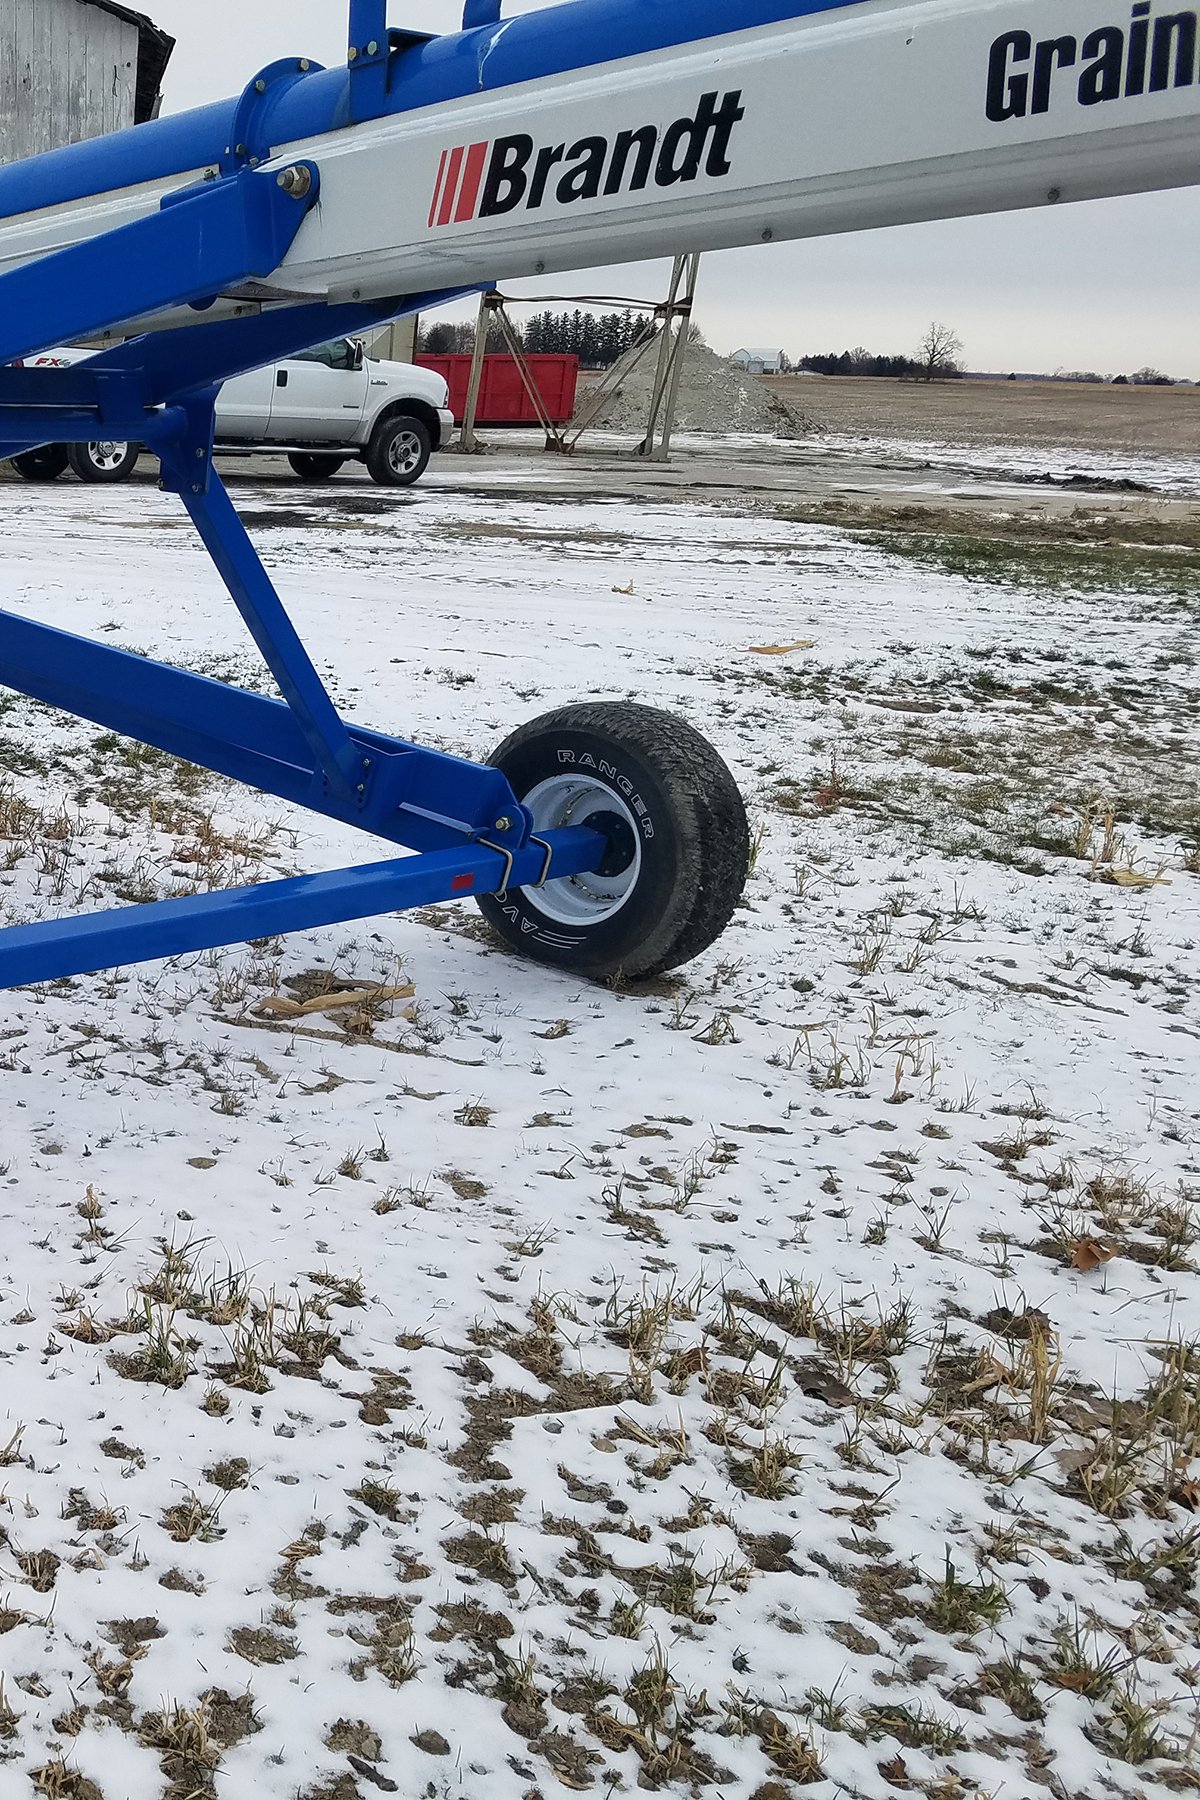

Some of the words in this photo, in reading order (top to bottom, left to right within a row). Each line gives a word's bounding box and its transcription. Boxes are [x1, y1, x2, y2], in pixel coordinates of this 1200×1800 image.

[478, 89, 745, 218] Brandt
[985, 1, 1200, 122] Grain
[557, 750, 655, 839] RANGER
